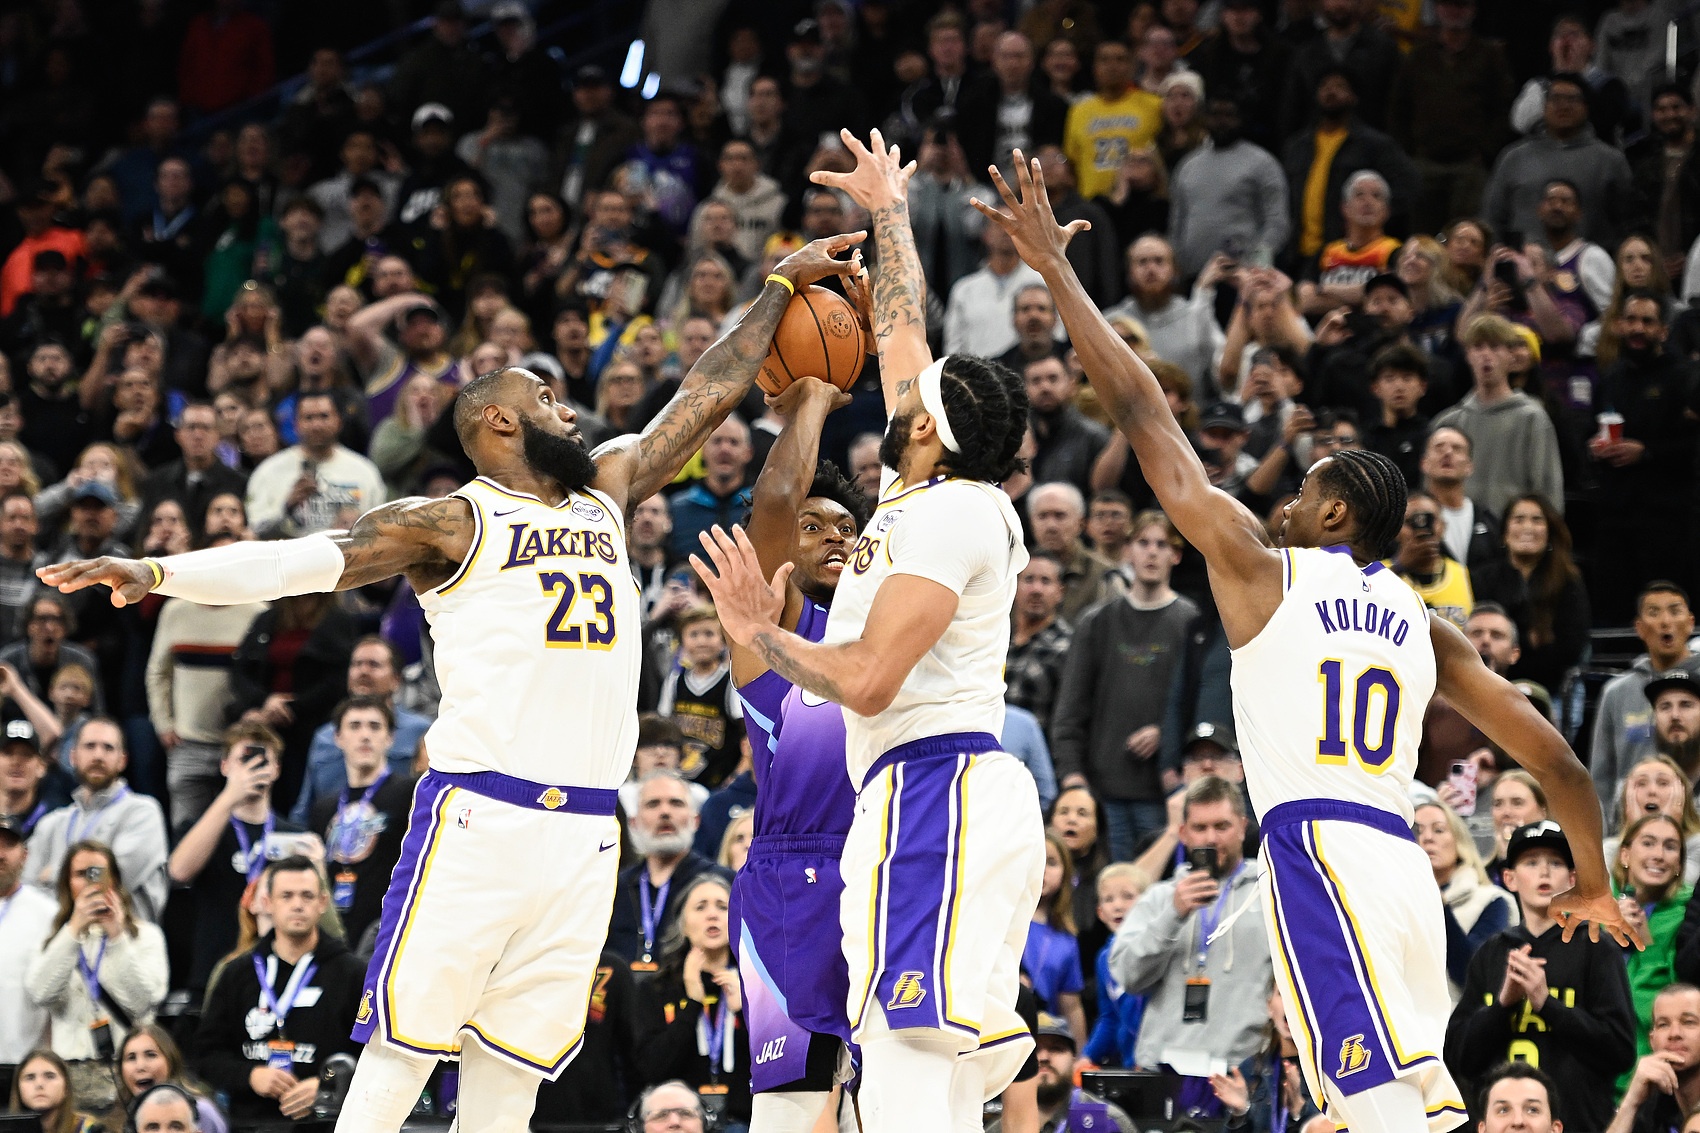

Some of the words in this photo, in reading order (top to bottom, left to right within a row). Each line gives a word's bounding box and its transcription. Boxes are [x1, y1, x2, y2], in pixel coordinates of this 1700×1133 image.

[500, 521, 618, 572] LAKERS
[536, 570, 618, 652] 23
[1315, 598, 1409, 647] KOLOKO
[1315, 657, 1402, 776] 10
[755, 1035, 787, 1065] JAZZ
